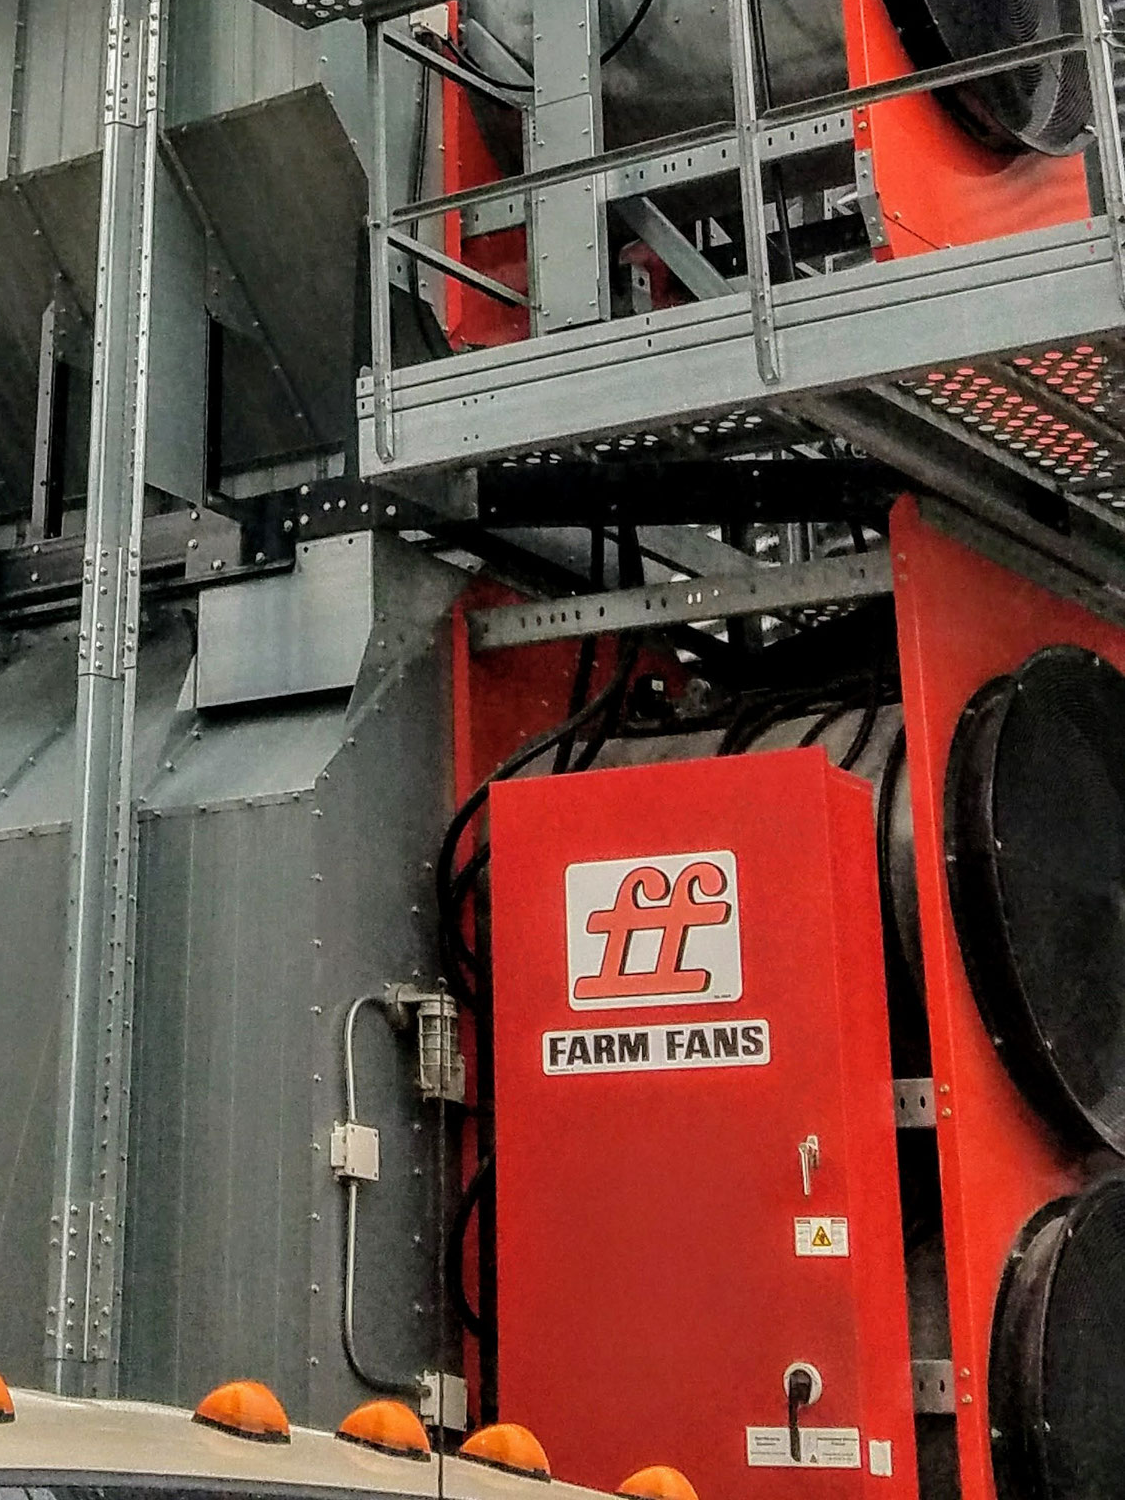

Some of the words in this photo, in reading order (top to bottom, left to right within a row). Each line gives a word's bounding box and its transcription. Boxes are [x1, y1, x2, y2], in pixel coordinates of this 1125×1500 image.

[574, 861, 732, 999] ff
[549, 1032, 650, 1066] FARM
[665, 1026, 763, 1061] FANS
